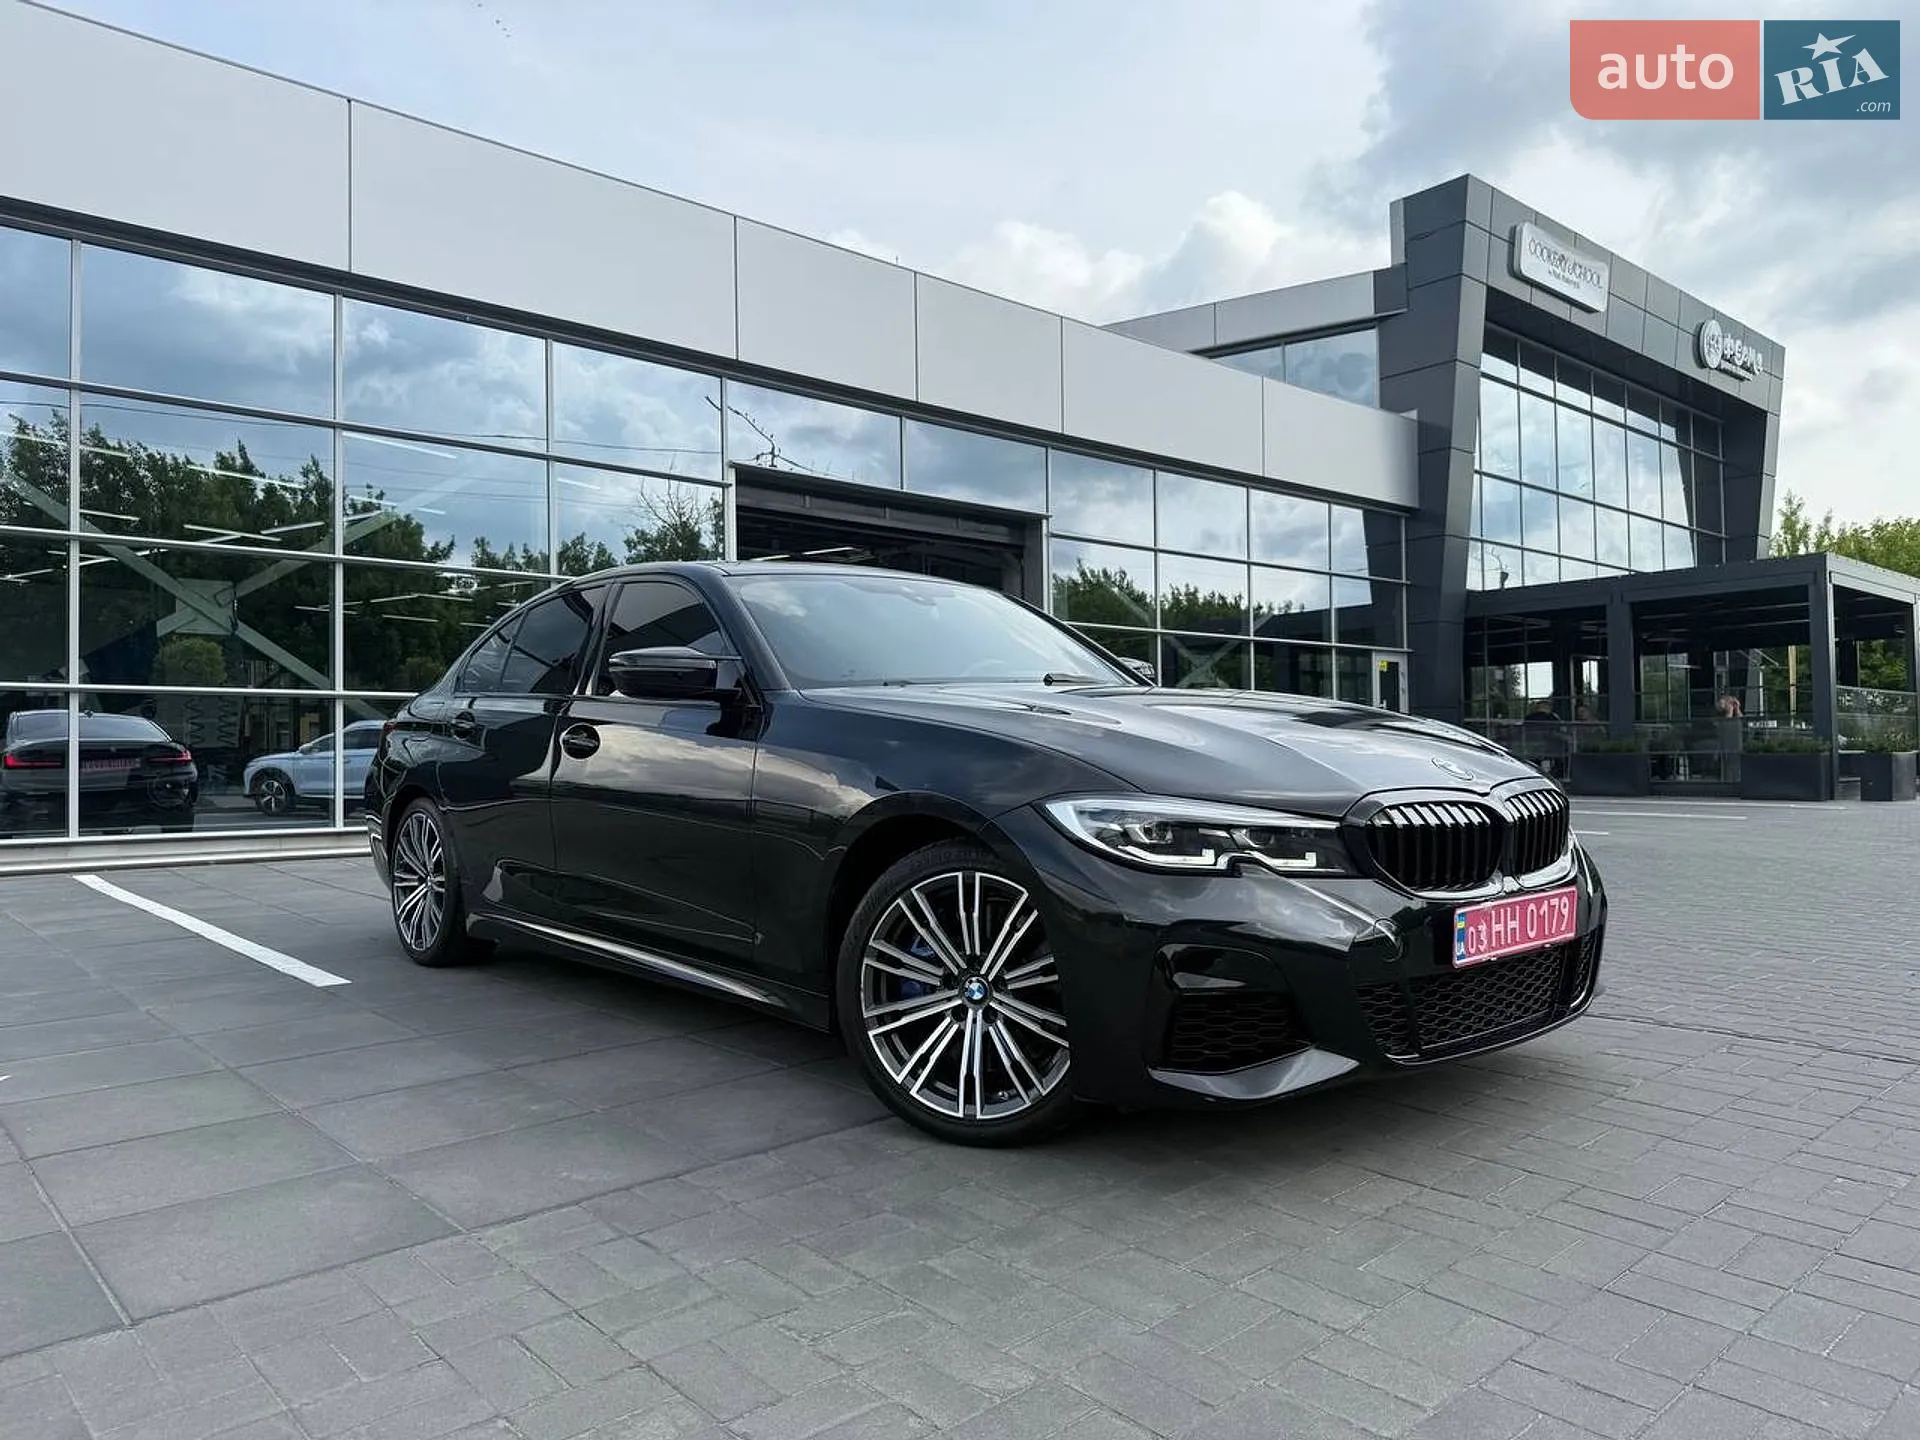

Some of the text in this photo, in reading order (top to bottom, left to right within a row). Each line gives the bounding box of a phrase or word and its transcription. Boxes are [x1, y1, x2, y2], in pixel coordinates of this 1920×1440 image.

[1468, 896, 1569, 954] 03 HH 0179
